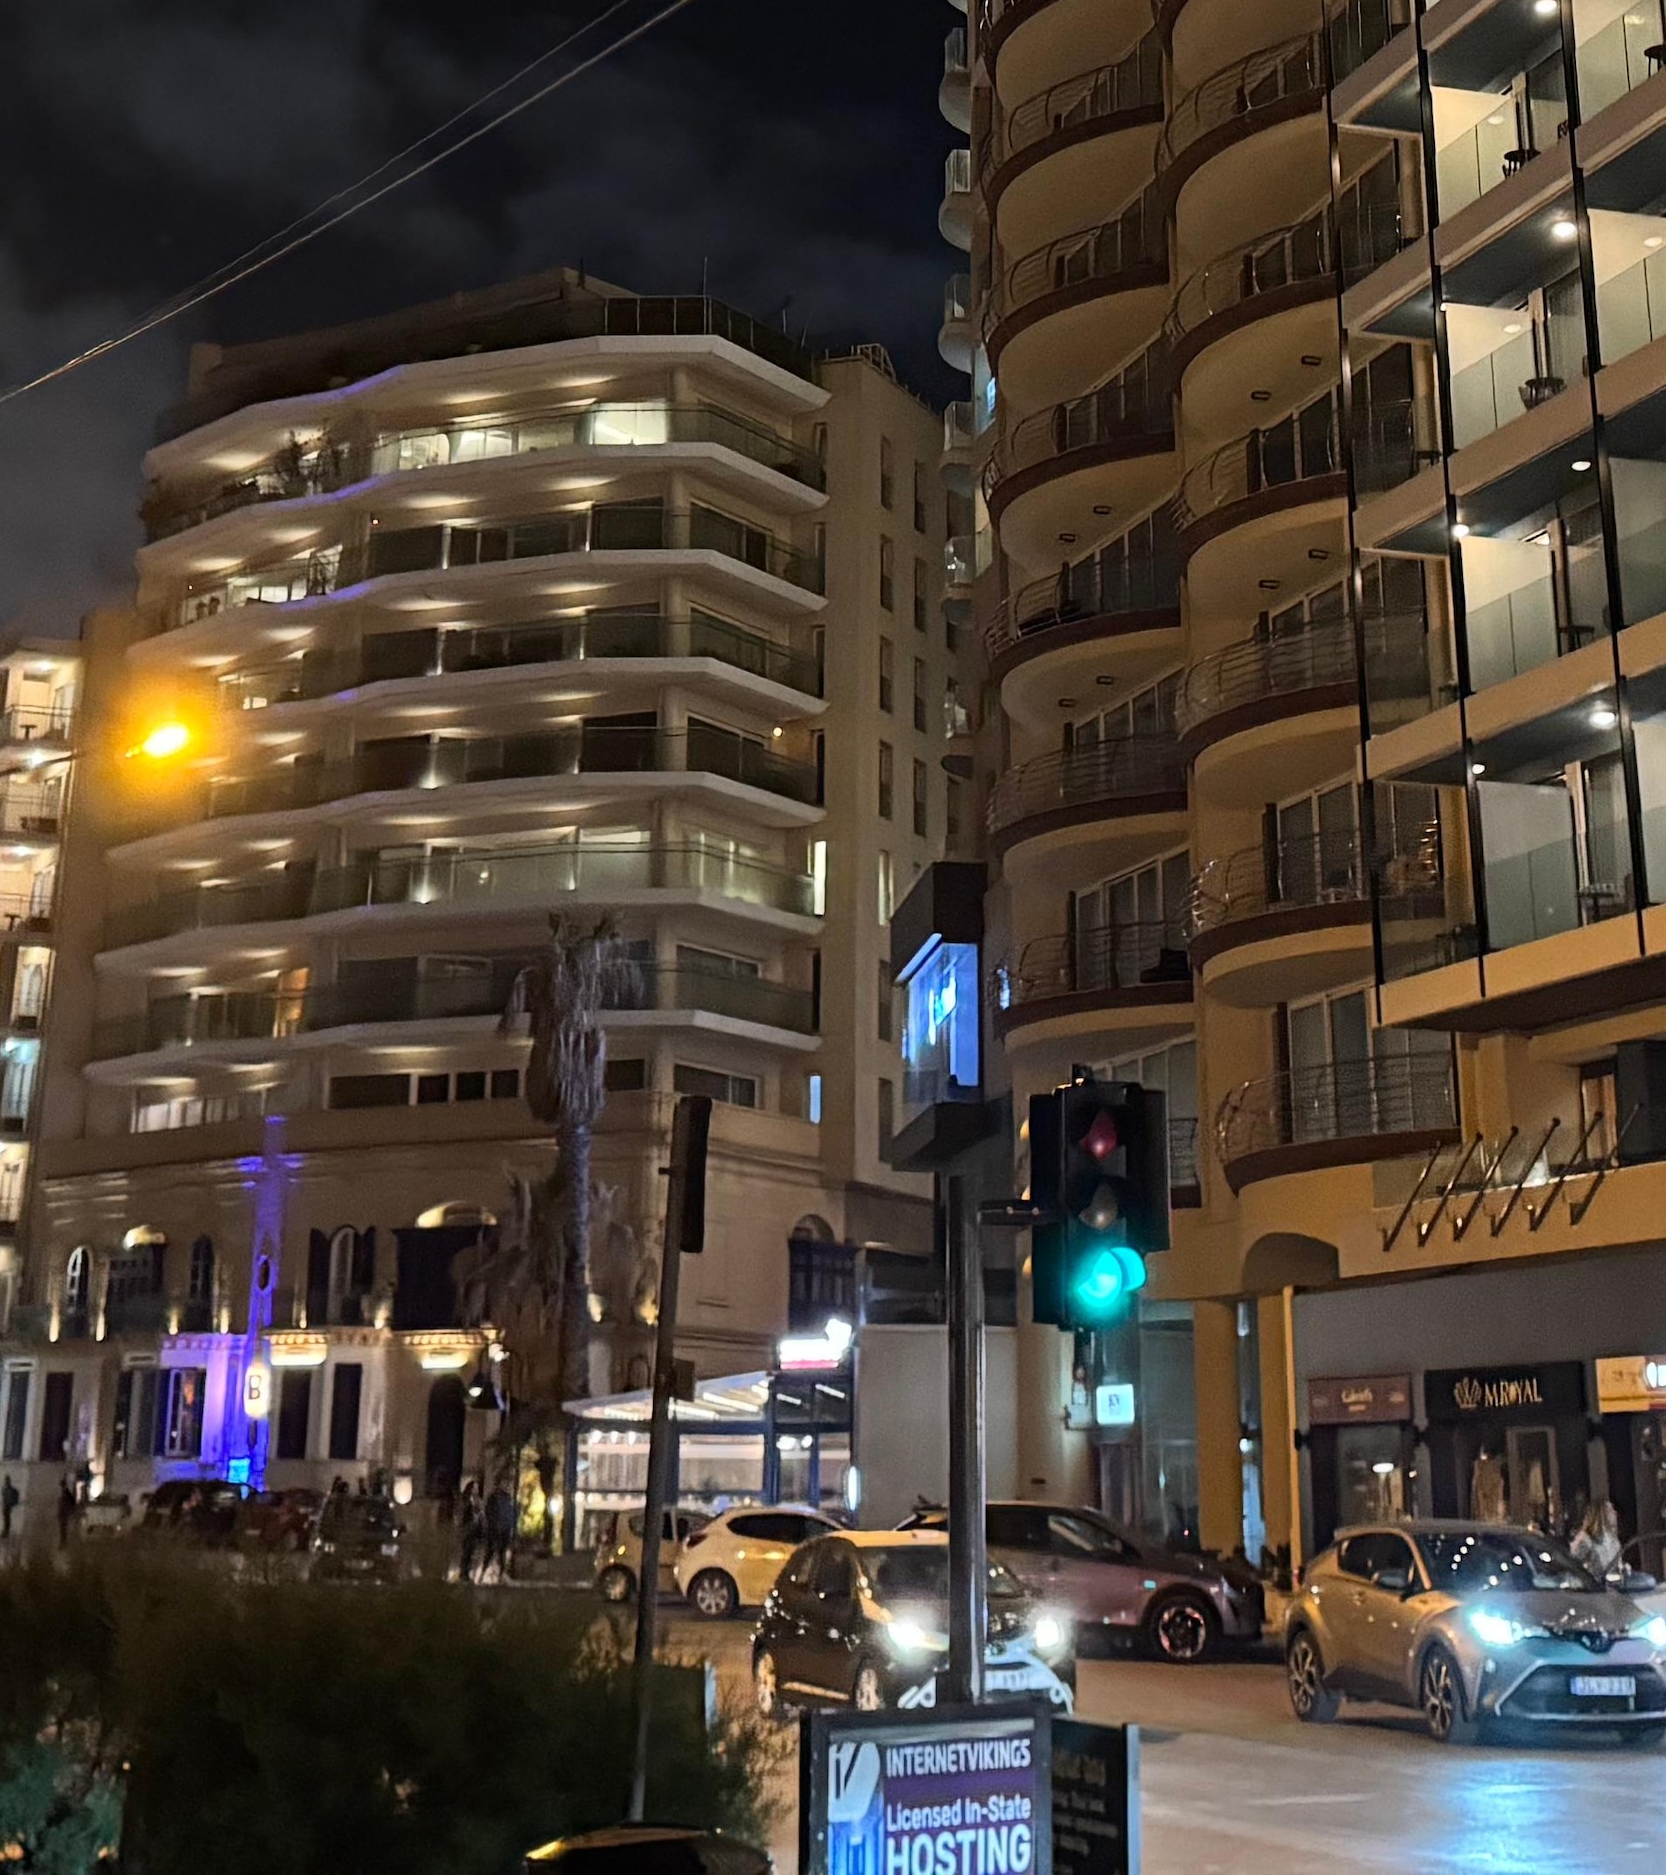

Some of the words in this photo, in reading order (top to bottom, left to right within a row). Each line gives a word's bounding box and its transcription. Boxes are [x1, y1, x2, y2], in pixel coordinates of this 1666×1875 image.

[886, 1738, 1031, 1778] INTERNETVIKINGS
[887, 1798, 962, 1832] Licensed
[964, 1793, 1032, 1824] In-State
[887, 1823, 1031, 1875] HOSTING
